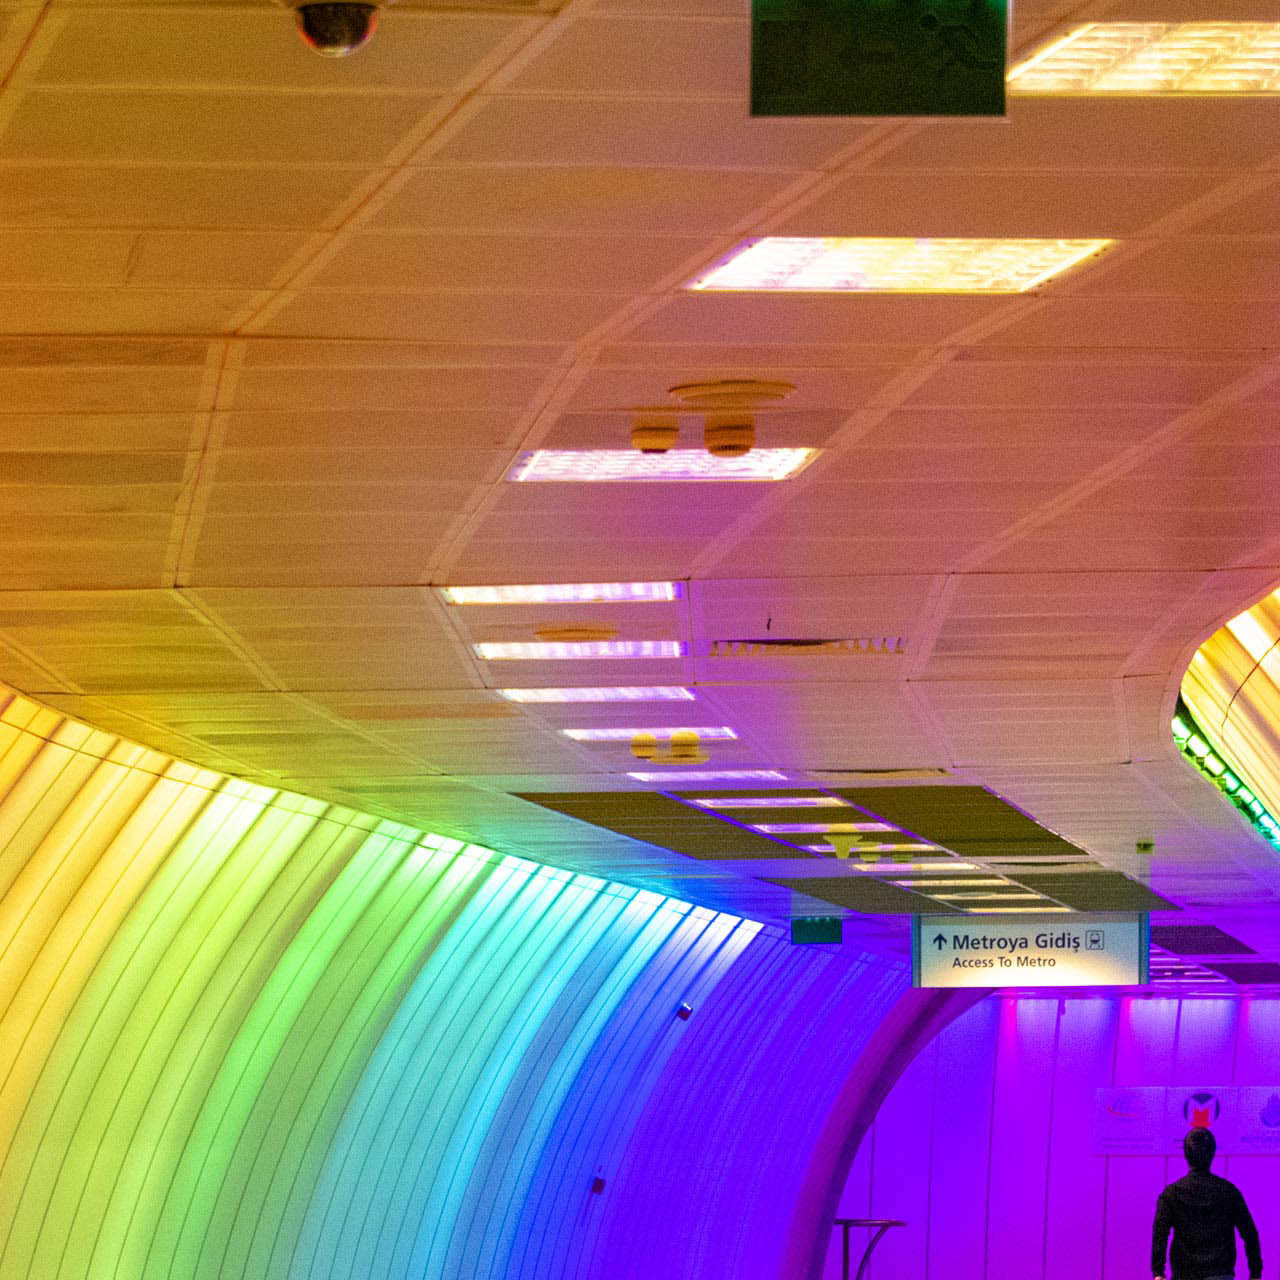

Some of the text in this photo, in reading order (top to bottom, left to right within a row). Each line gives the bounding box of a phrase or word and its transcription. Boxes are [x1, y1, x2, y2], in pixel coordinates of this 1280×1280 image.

[952, 932, 1080, 953] Metroya Gidiş
[952, 956, 1056, 968] Access To Metro
